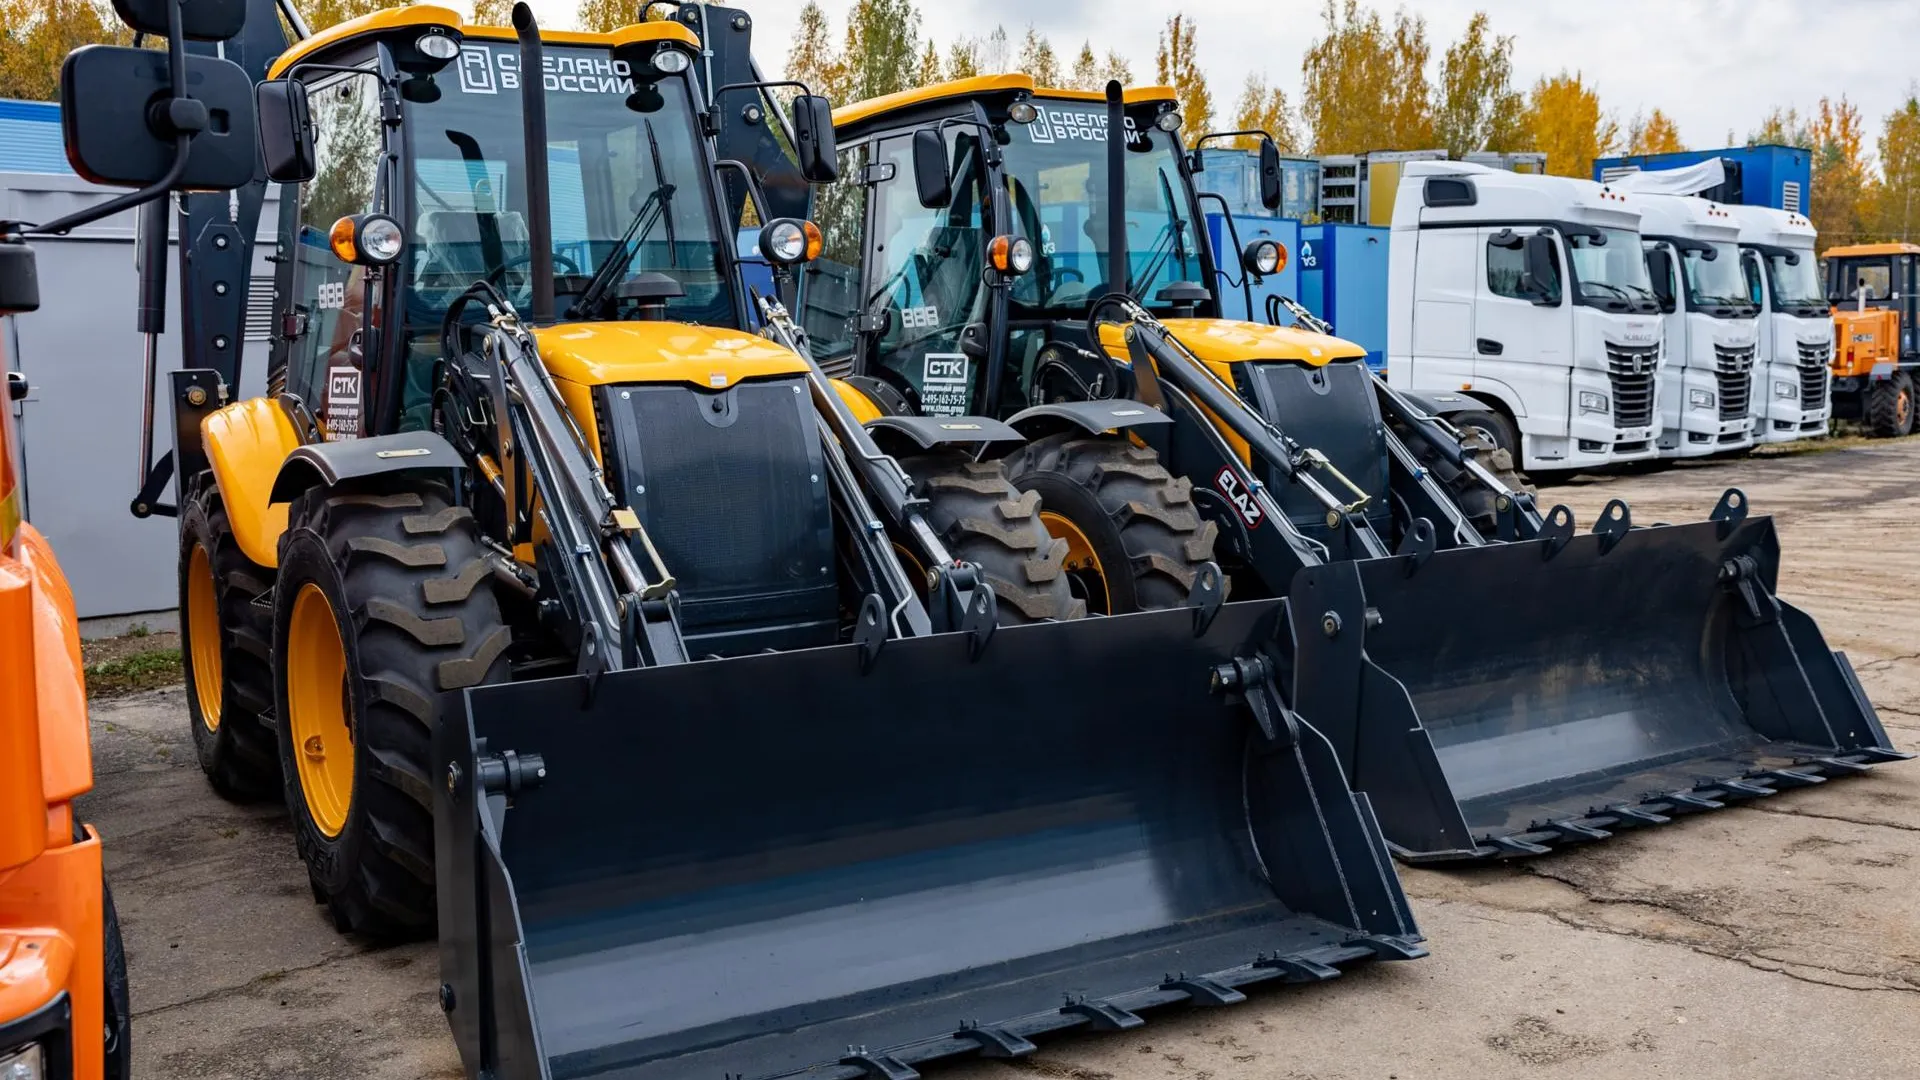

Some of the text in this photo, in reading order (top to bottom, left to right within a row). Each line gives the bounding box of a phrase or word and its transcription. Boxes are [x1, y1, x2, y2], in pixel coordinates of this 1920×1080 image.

[497, 53, 632, 76] СЕЛАНО
[543, 74, 637, 94] ОССИИ
[1049, 112, 1136, 129] СДЕЛАО
[930, 361, 962, 375] СТК
[333, 377, 357, 394] СТК
[1218, 469, 1261, 525] ELAZ
